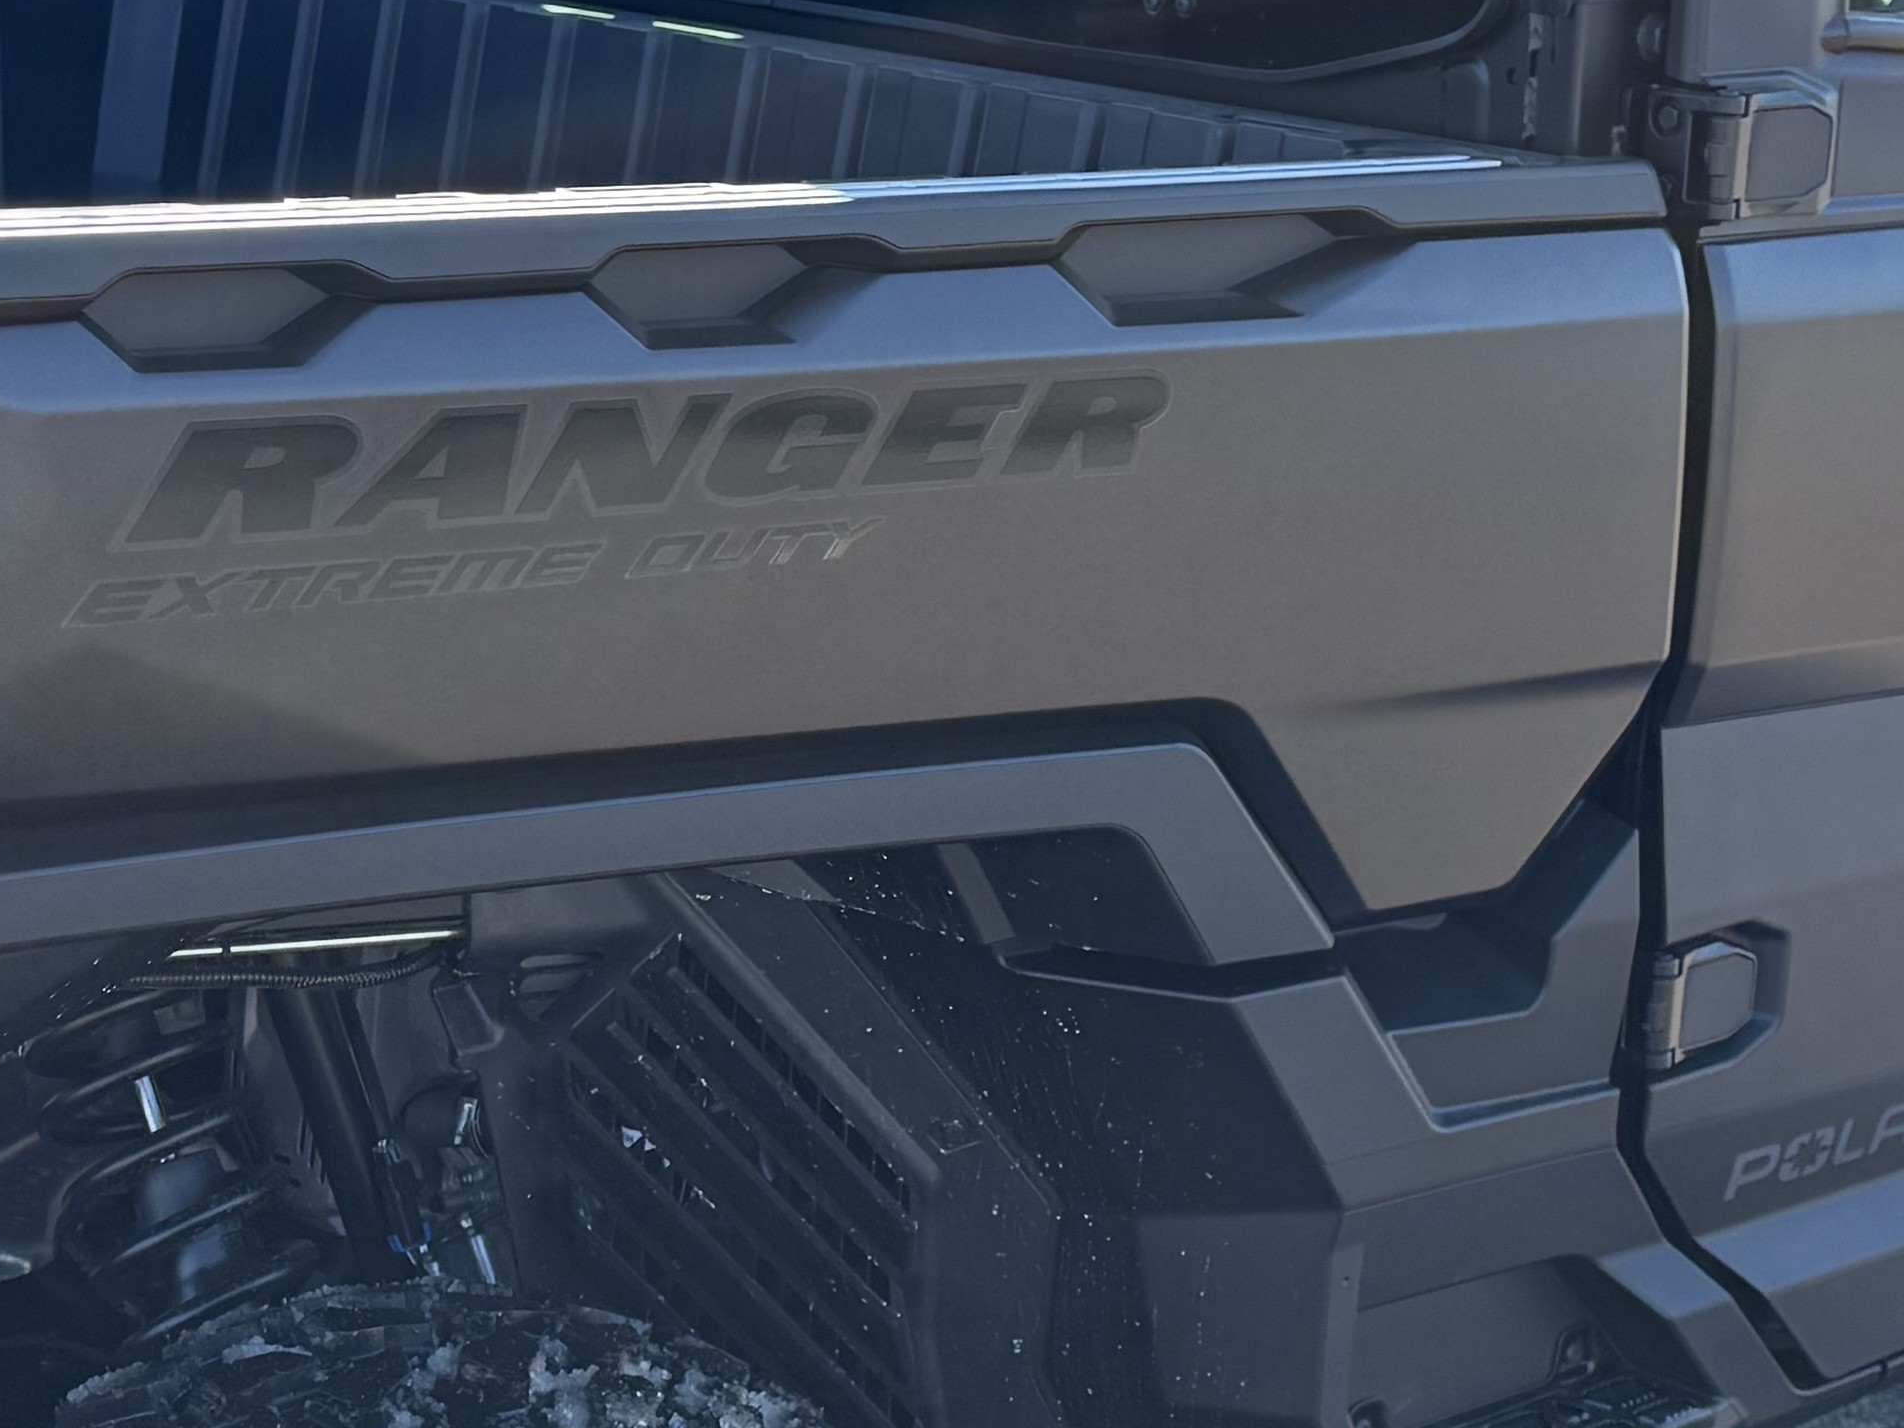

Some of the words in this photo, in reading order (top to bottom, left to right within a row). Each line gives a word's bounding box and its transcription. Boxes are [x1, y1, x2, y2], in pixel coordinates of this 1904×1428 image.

[108, 369, 1172, 553] RANGER
[63, 540, 604, 628] EXTREME
[626, 516, 889, 580] DUTY
